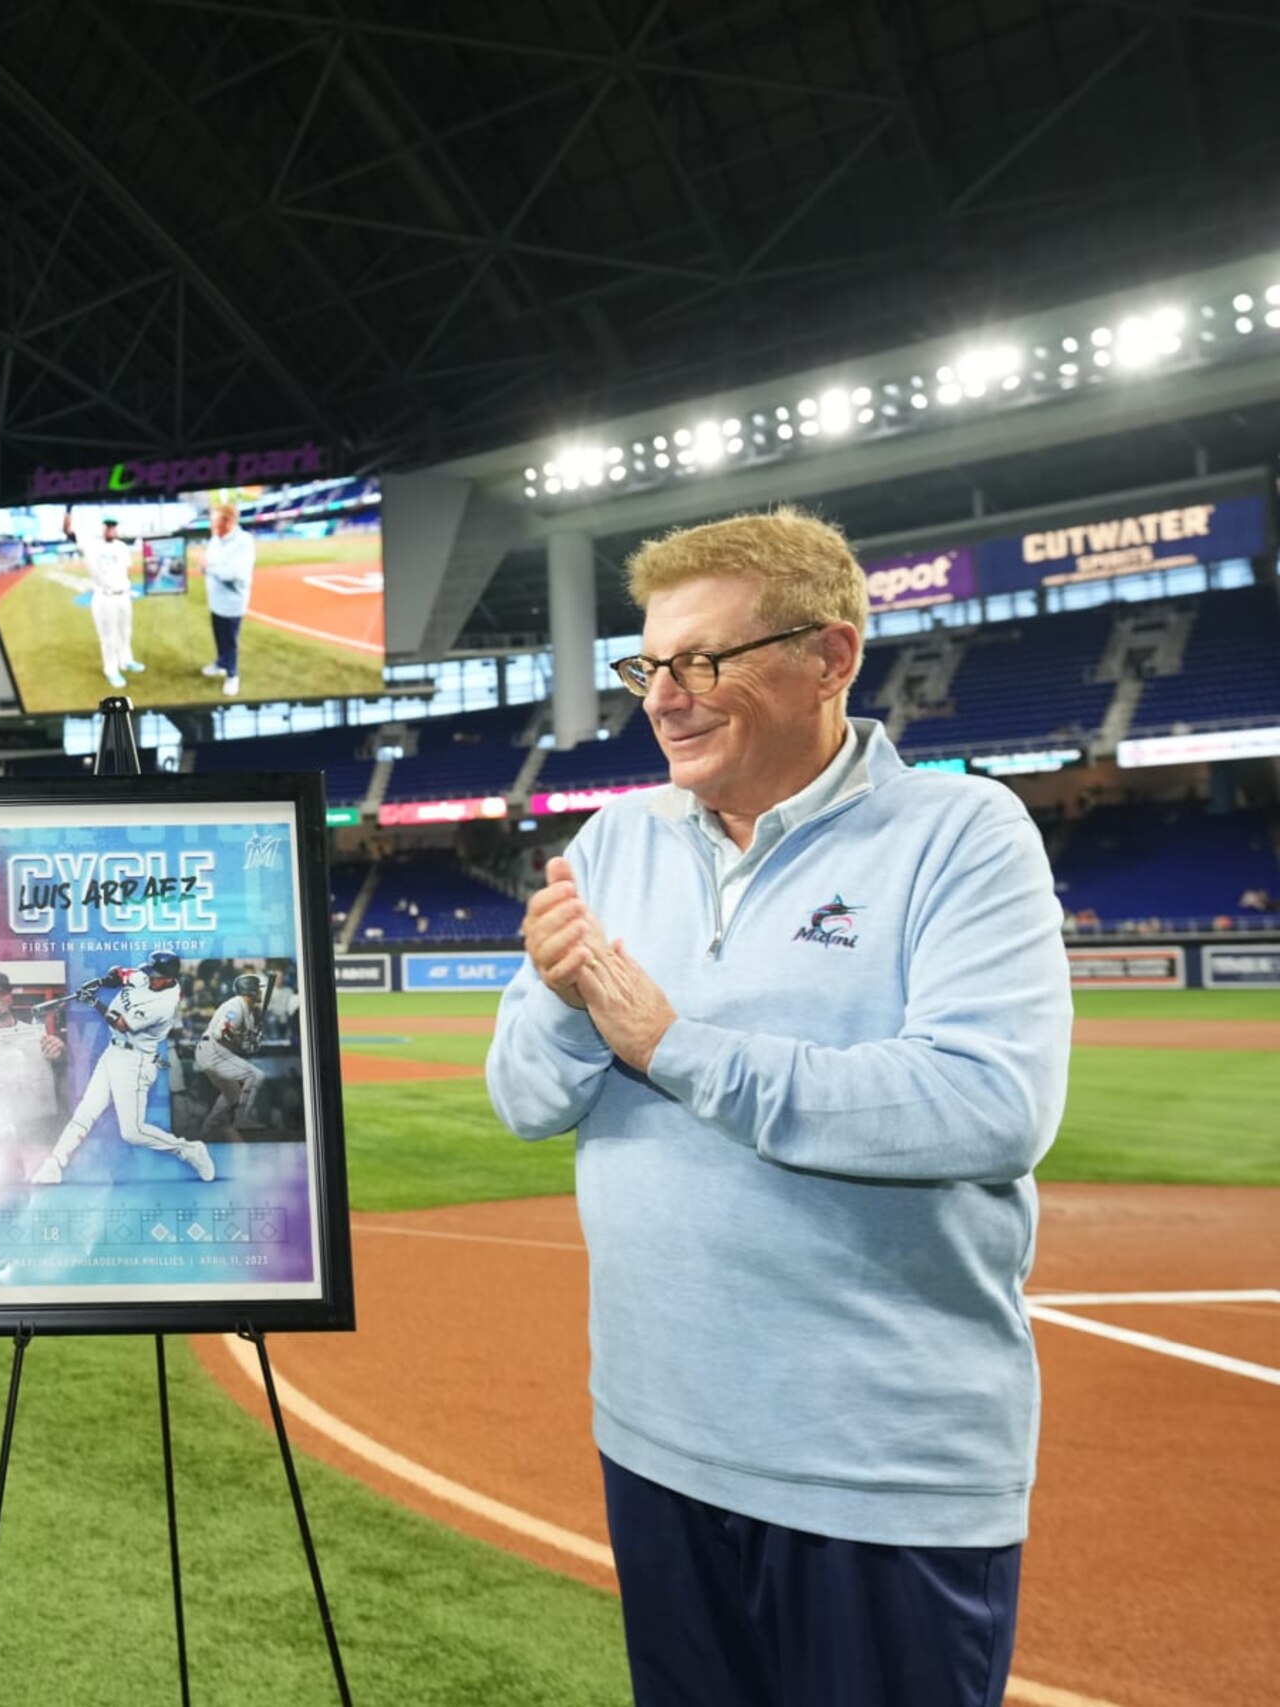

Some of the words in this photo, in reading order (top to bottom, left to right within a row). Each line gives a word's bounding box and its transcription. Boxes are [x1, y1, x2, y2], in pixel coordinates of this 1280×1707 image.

[234, 442, 324, 484] park
[1023, 505, 1211, 563] CUTWATER
[866, 554, 952, 602] epot
[7, 851, 218, 934] CYCLE
[17, 882, 72, 912] LUIS
[82, 875, 198, 909] ARRAEZ
[21, 941, 56, 952] FIRST
[62, 941, 75, 951] IN
[80, 940, 148, 951] FRANCHISE
[153, 939, 206, 951] HISTORY
[143, 1255, 185, 1266] PHILLIES
[200, 1255, 227, 1265] APRIL
[245, 1255, 269, 1265] 2023
